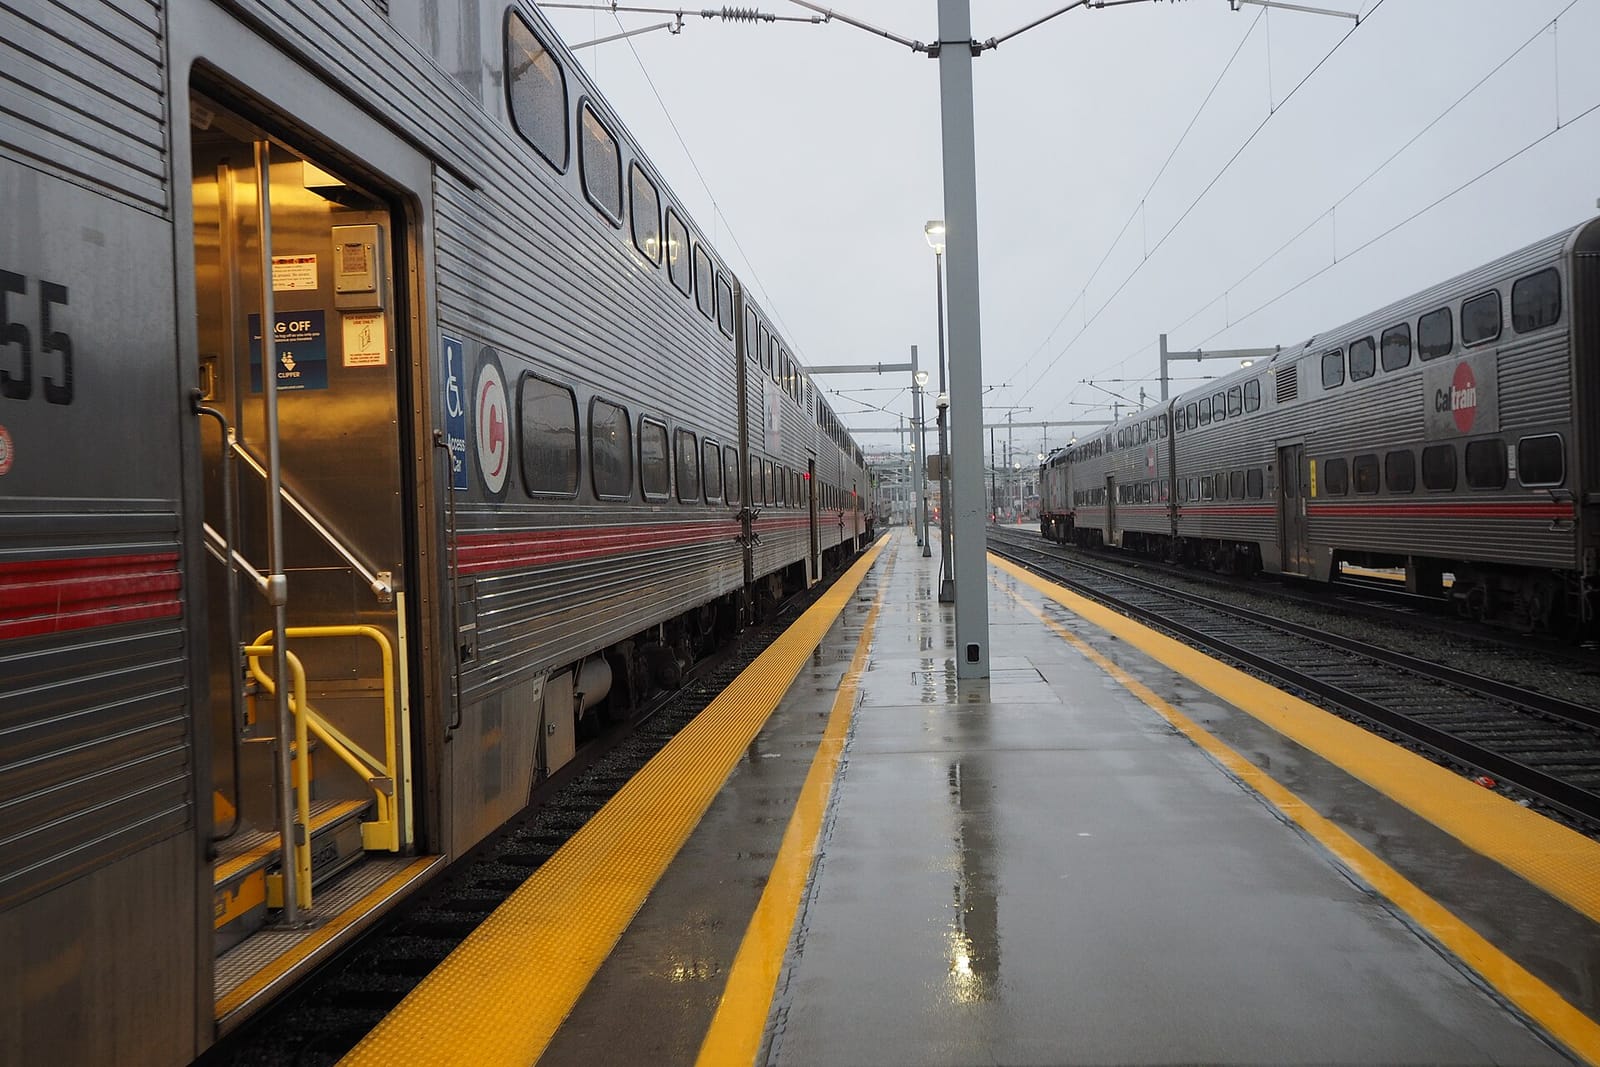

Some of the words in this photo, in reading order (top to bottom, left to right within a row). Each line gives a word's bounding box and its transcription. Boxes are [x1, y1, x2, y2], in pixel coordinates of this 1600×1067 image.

[289, 320, 311, 332] OFF
[277, 371, 301, 379] CLIPPER
[1435, 381, 1477, 413] Caltrain
